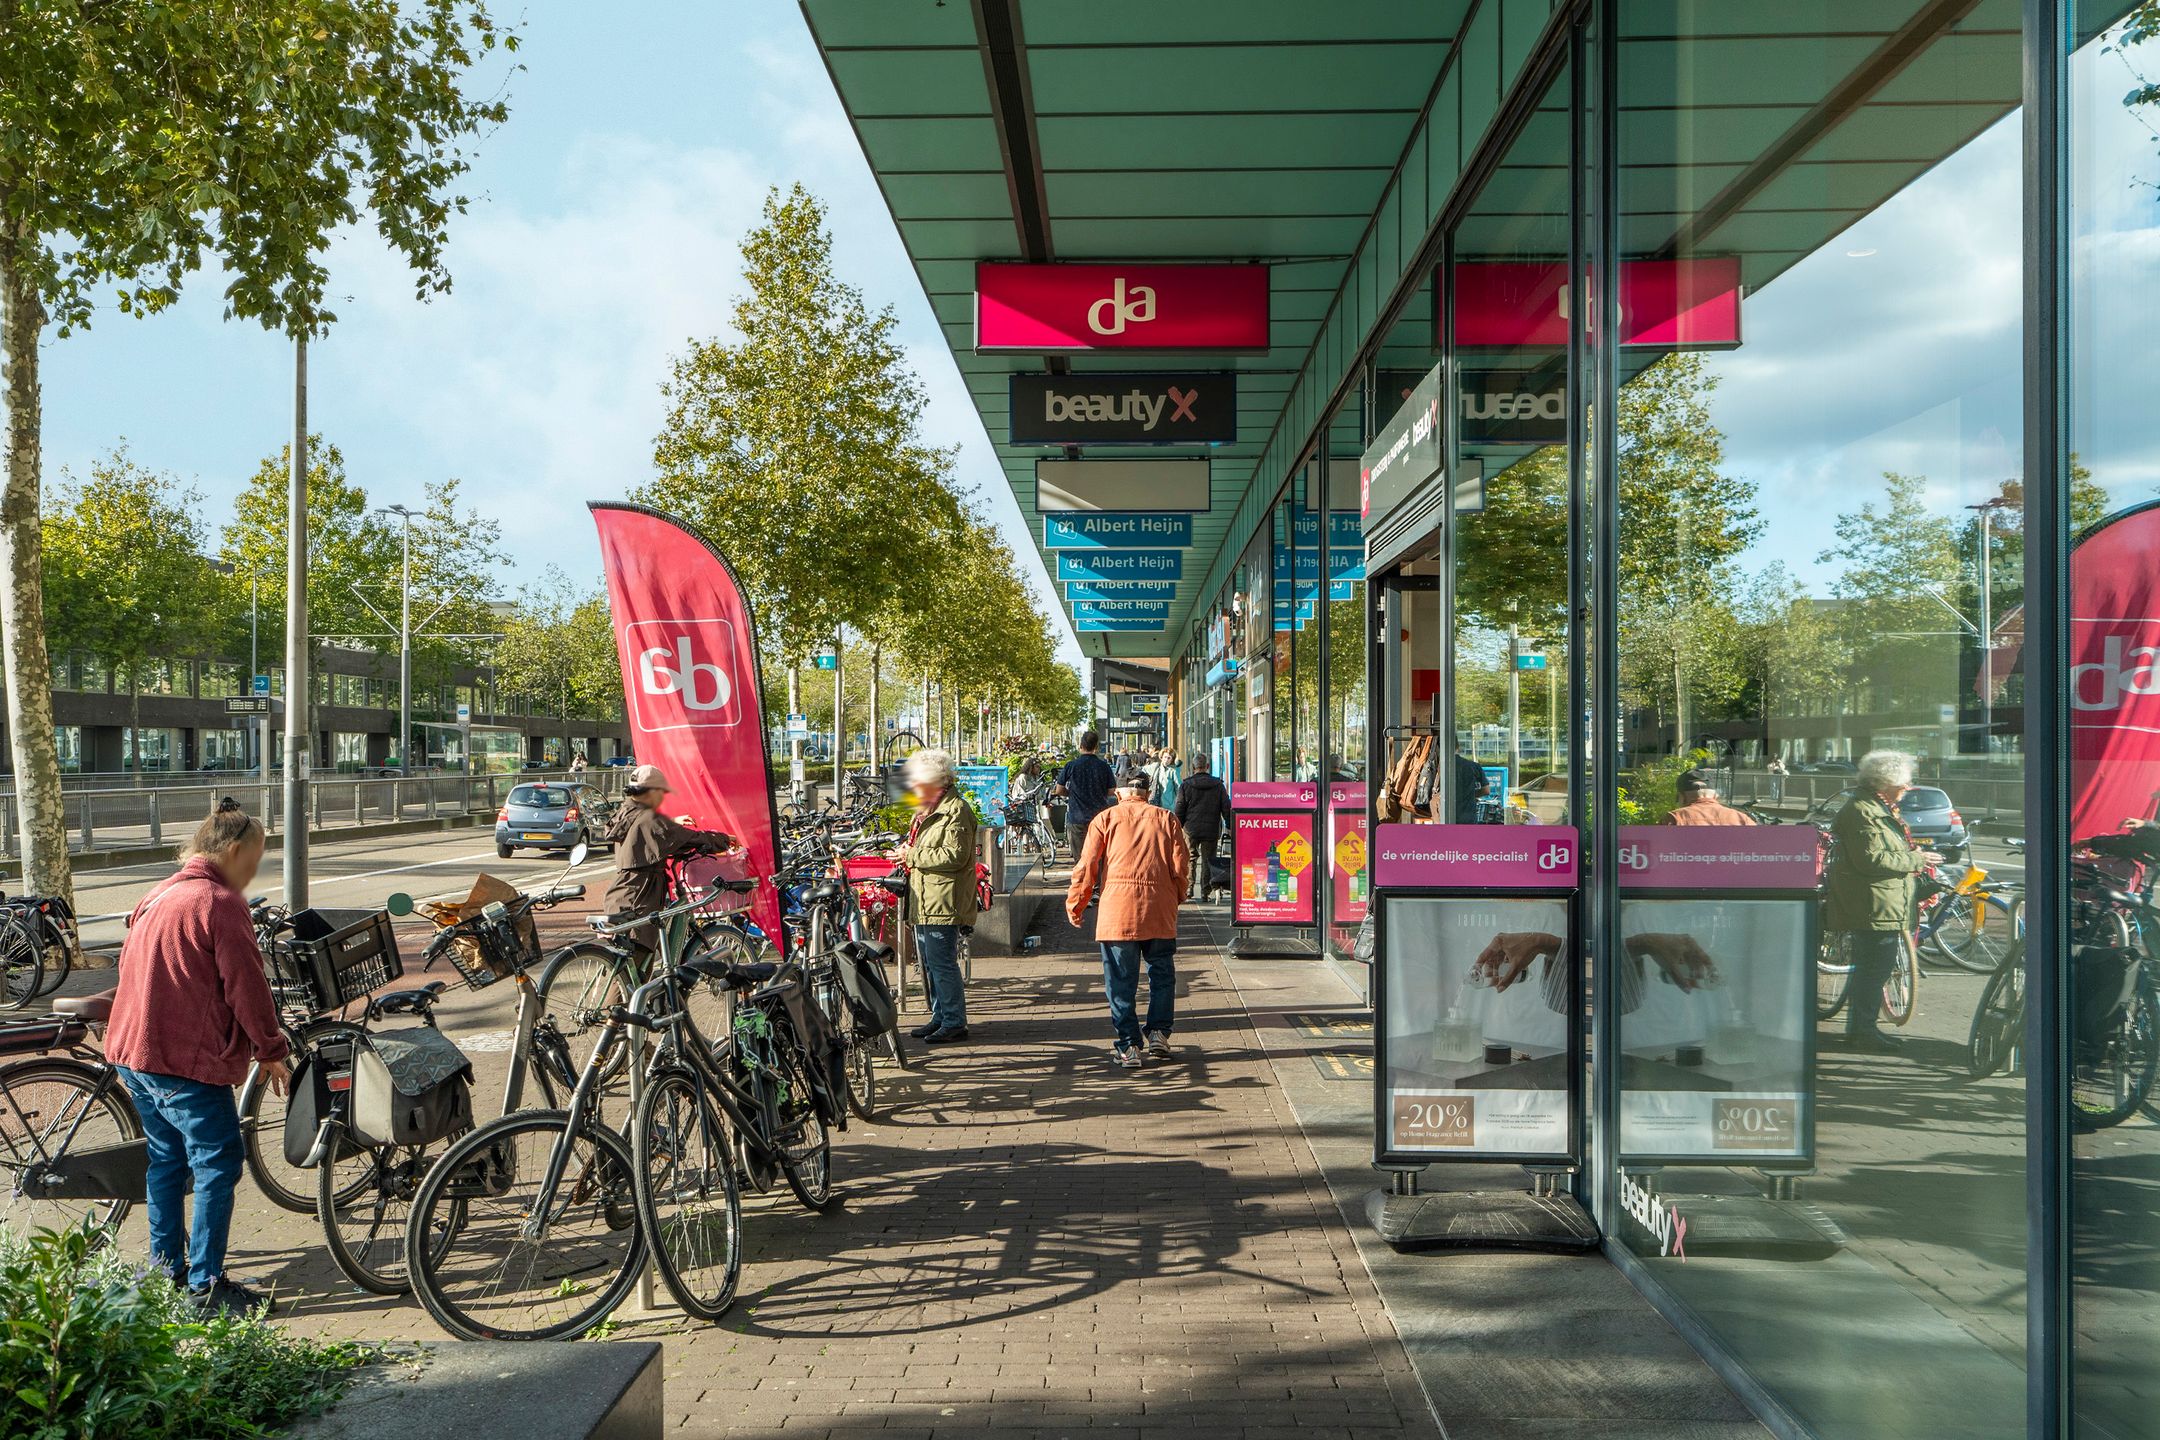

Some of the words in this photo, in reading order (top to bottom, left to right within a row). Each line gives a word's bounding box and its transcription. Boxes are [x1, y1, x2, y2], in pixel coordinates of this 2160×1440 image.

[1088, 278, 1156, 335] da
[1084, 519, 1136, 532] Albert
[1141, 518, 1183, 535] Heijn
[1091, 556, 1135, 568] Albert
[1139, 556, 1174, 570] Heijn
[1099, 601, 1133, 610] Albert
[1135, 601, 1163, 612] Heijn
[1300, 790, 1314, 801] da
[1240, 819, 1260, 829] PAK
[1262, 819, 1288, 829] MEE!
[1286, 840, 1303, 854] 2e
[1382, 849, 1398, 862] de
[1400, 850, 1469, 864] vriendelijke
[1471, 851, 1529, 864] specialist
[1538, 844, 1569, 870] da
